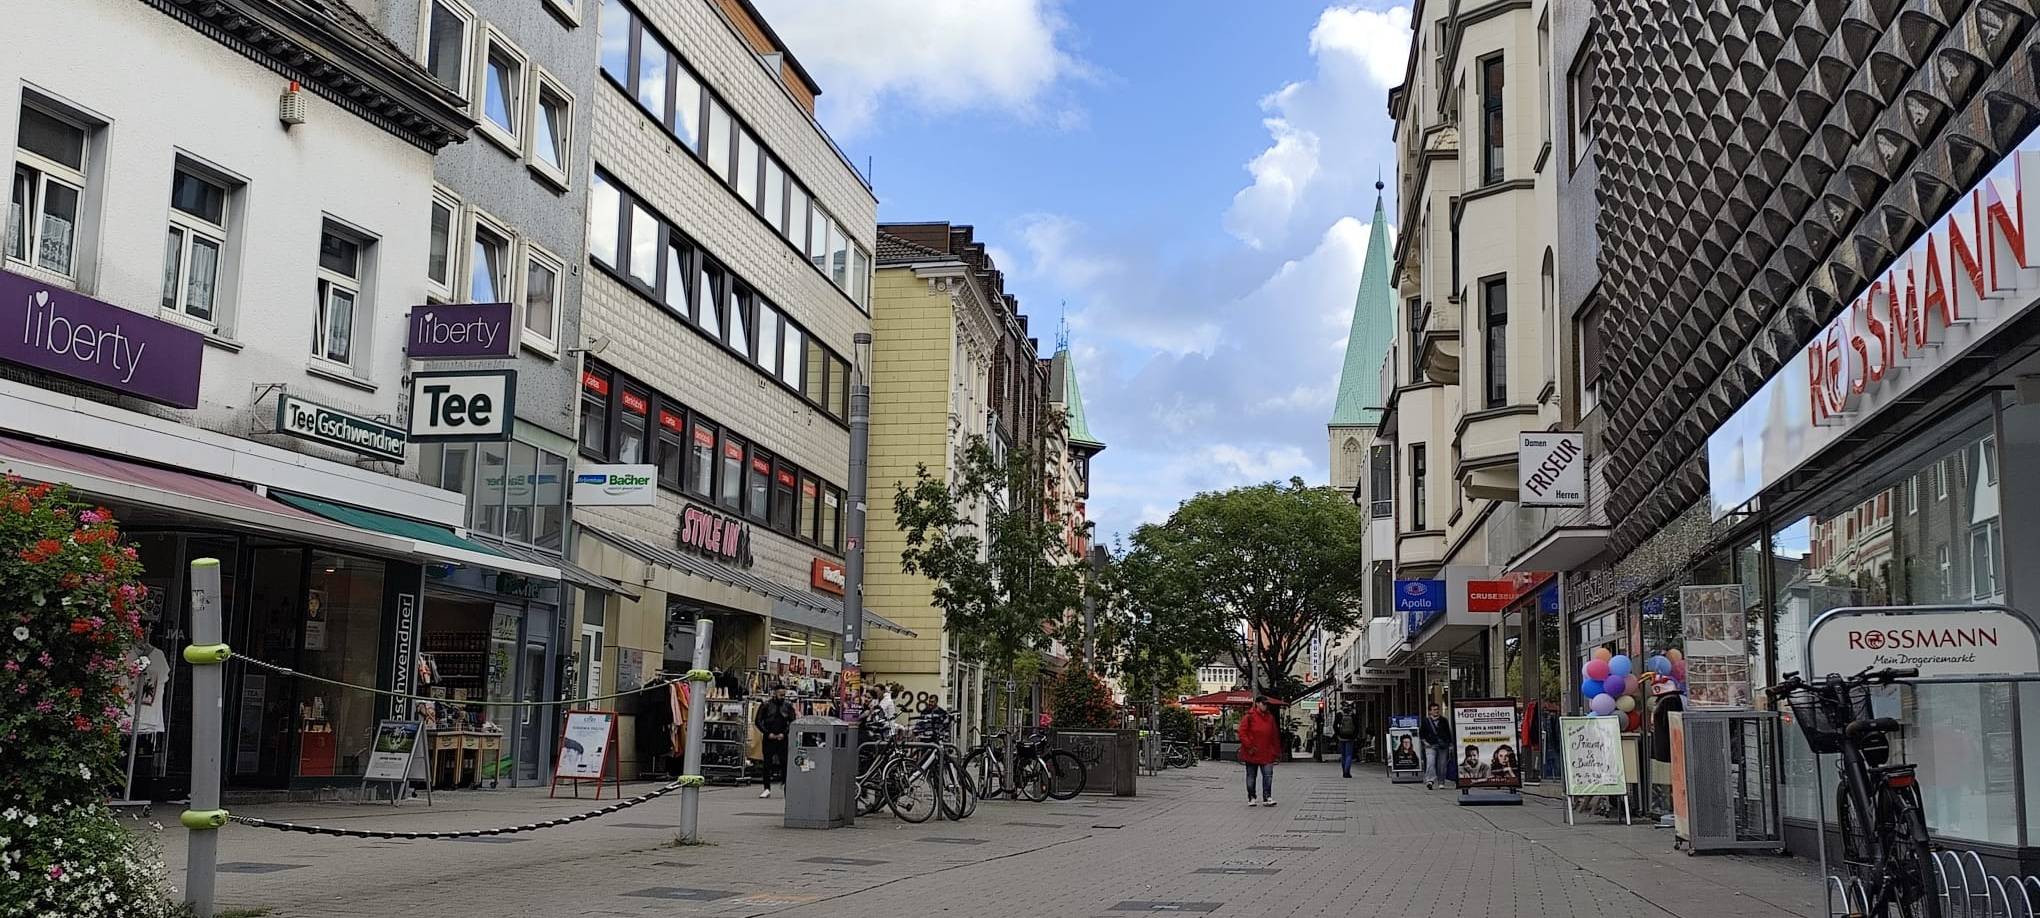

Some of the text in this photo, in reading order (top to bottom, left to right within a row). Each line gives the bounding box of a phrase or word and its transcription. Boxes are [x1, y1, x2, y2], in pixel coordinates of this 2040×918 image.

[1807, 148, 2027, 428] ROSSMANN
[24, 290, 146, 384] liberty
[418, 311, 501, 349] liberty
[423, 385, 493, 428] Tee
[289, 403, 406, 456] Tee Gschwendner
[1524, 438, 1547, 447] Damen
[609, 474, 651, 486] Bacher
[1525, 438, 1582, 497] FRISEUR
[1556, 489, 1579, 499] Herren
[681, 506, 741, 558] STYLE IN
[1401, 598, 1432, 609] Apollo
[1848, 627, 1998, 650] ROSSMANN
[1873, 652, 1976, 668] Mein Drogeriemarkt
[901, 690, 929, 713] 28
